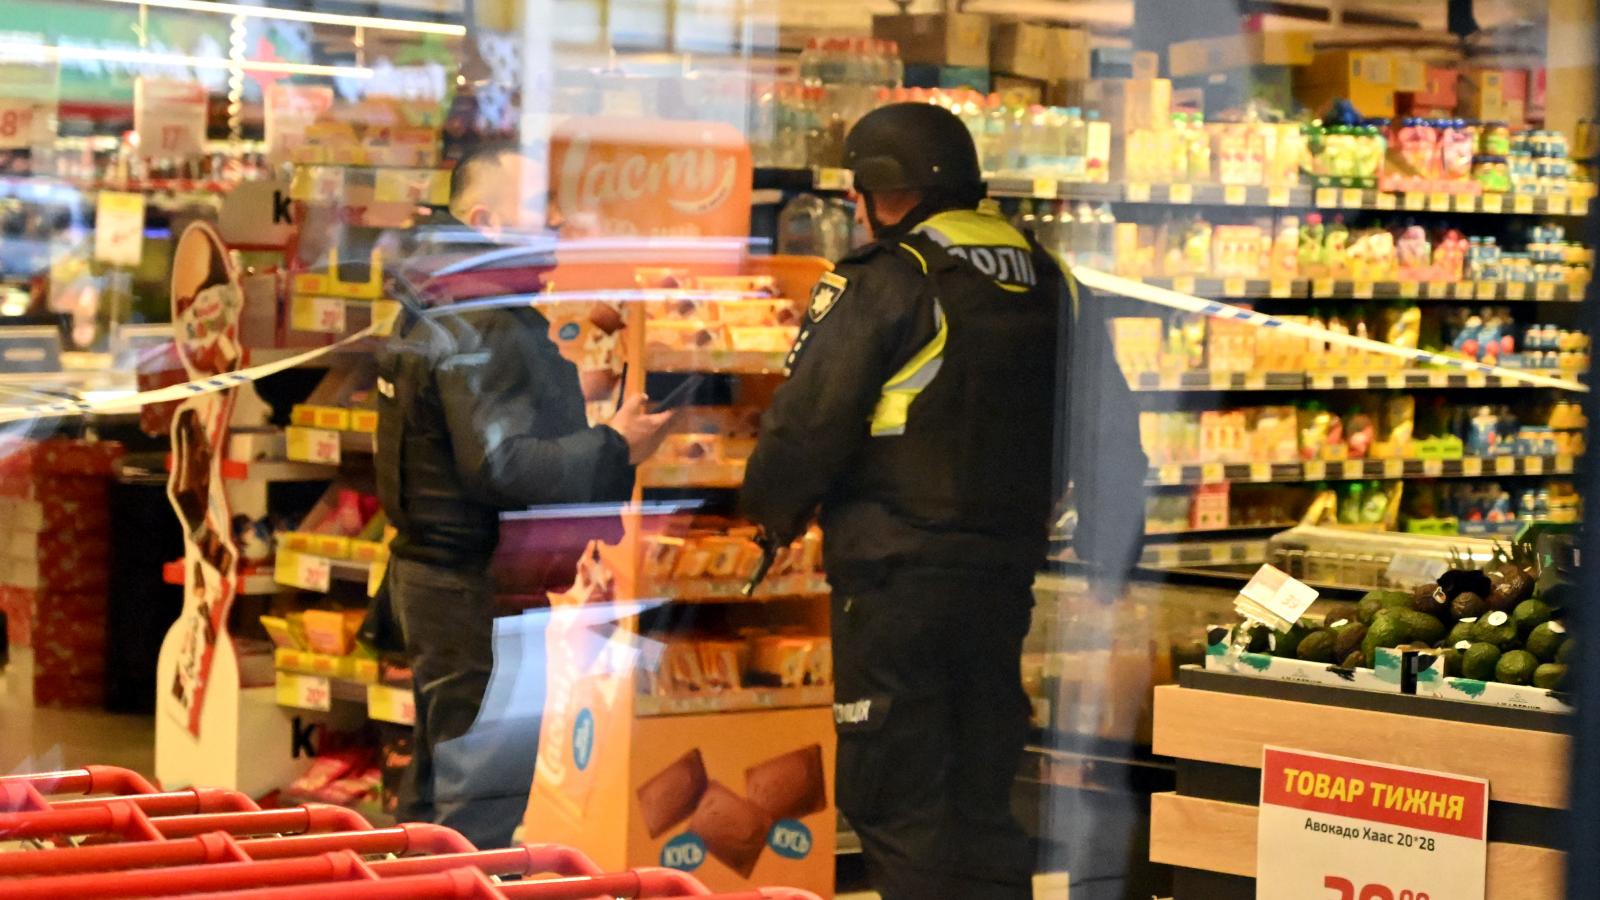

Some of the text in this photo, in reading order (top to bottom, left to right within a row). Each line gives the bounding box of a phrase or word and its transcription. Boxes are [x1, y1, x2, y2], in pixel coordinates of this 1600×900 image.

[1282, 767, 1465, 822] ТОВАР ТИЖНЯ
[1304, 817, 1360, 839] Авокадо
[1362, 827, 1394, 845] Хаас
